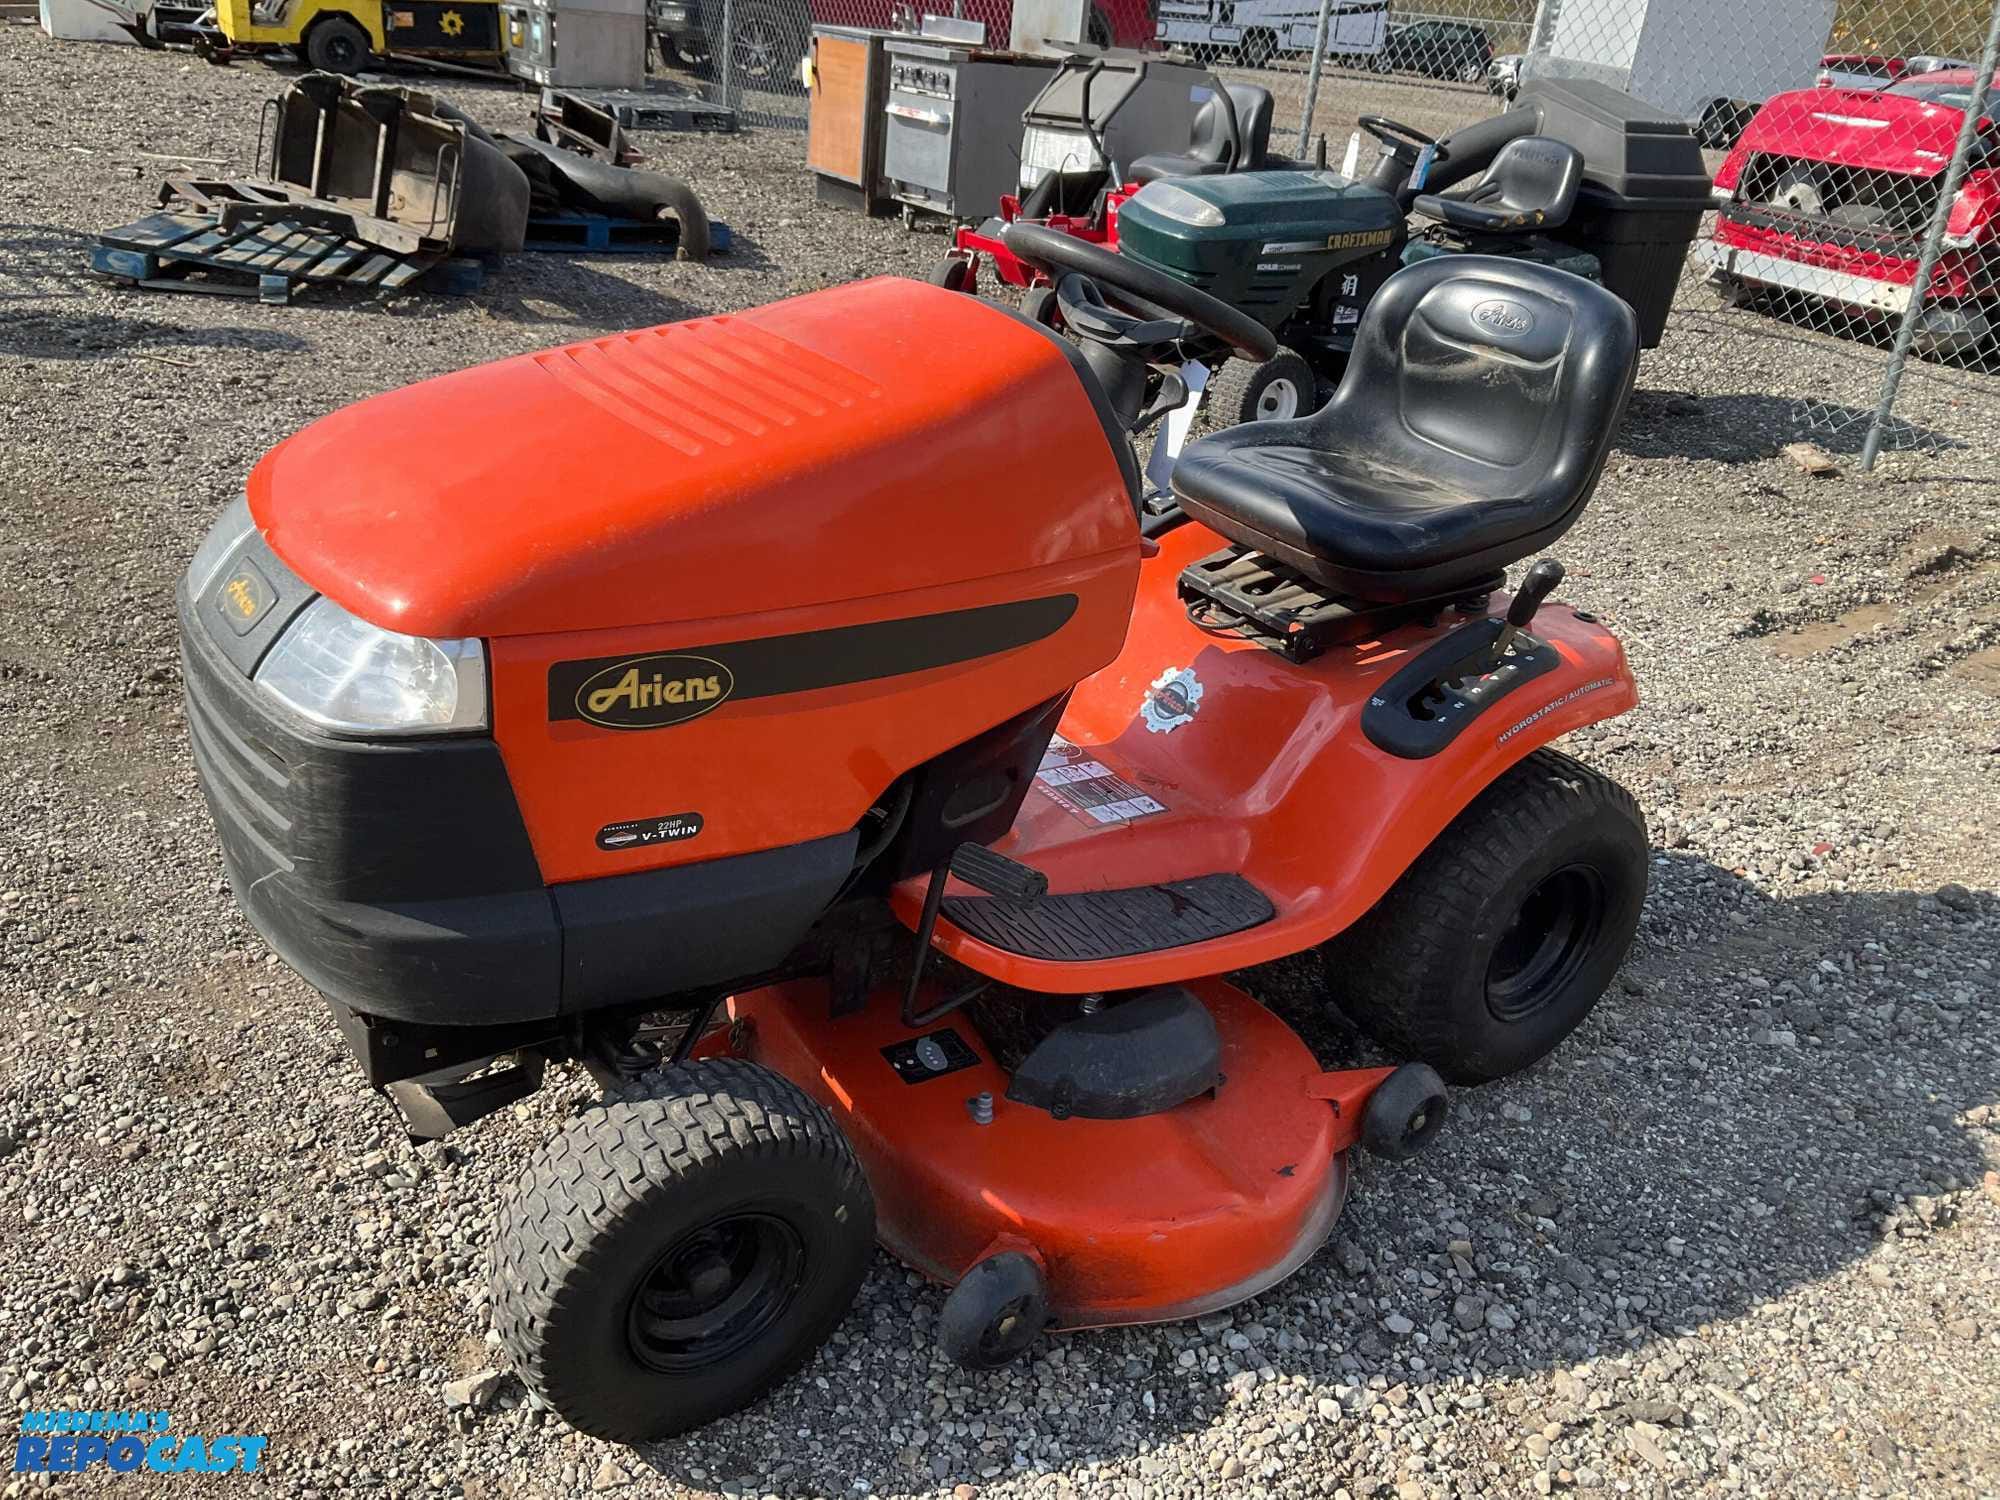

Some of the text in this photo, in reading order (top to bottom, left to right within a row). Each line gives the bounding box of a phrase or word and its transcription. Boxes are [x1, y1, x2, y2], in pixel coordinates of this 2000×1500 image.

[1328, 230, 1392, 249] CRAFTSMAN
[1479, 304, 1528, 331] Ariens
[227, 580, 257, 617] Ariens
[587, 668, 721, 713] Ariens
[1498, 678, 1615, 744] HYDROSTATIC/AUTOMATIC
[642, 825, 697, 841] V-TWIN
[658, 819, 682, 831] 22HP
